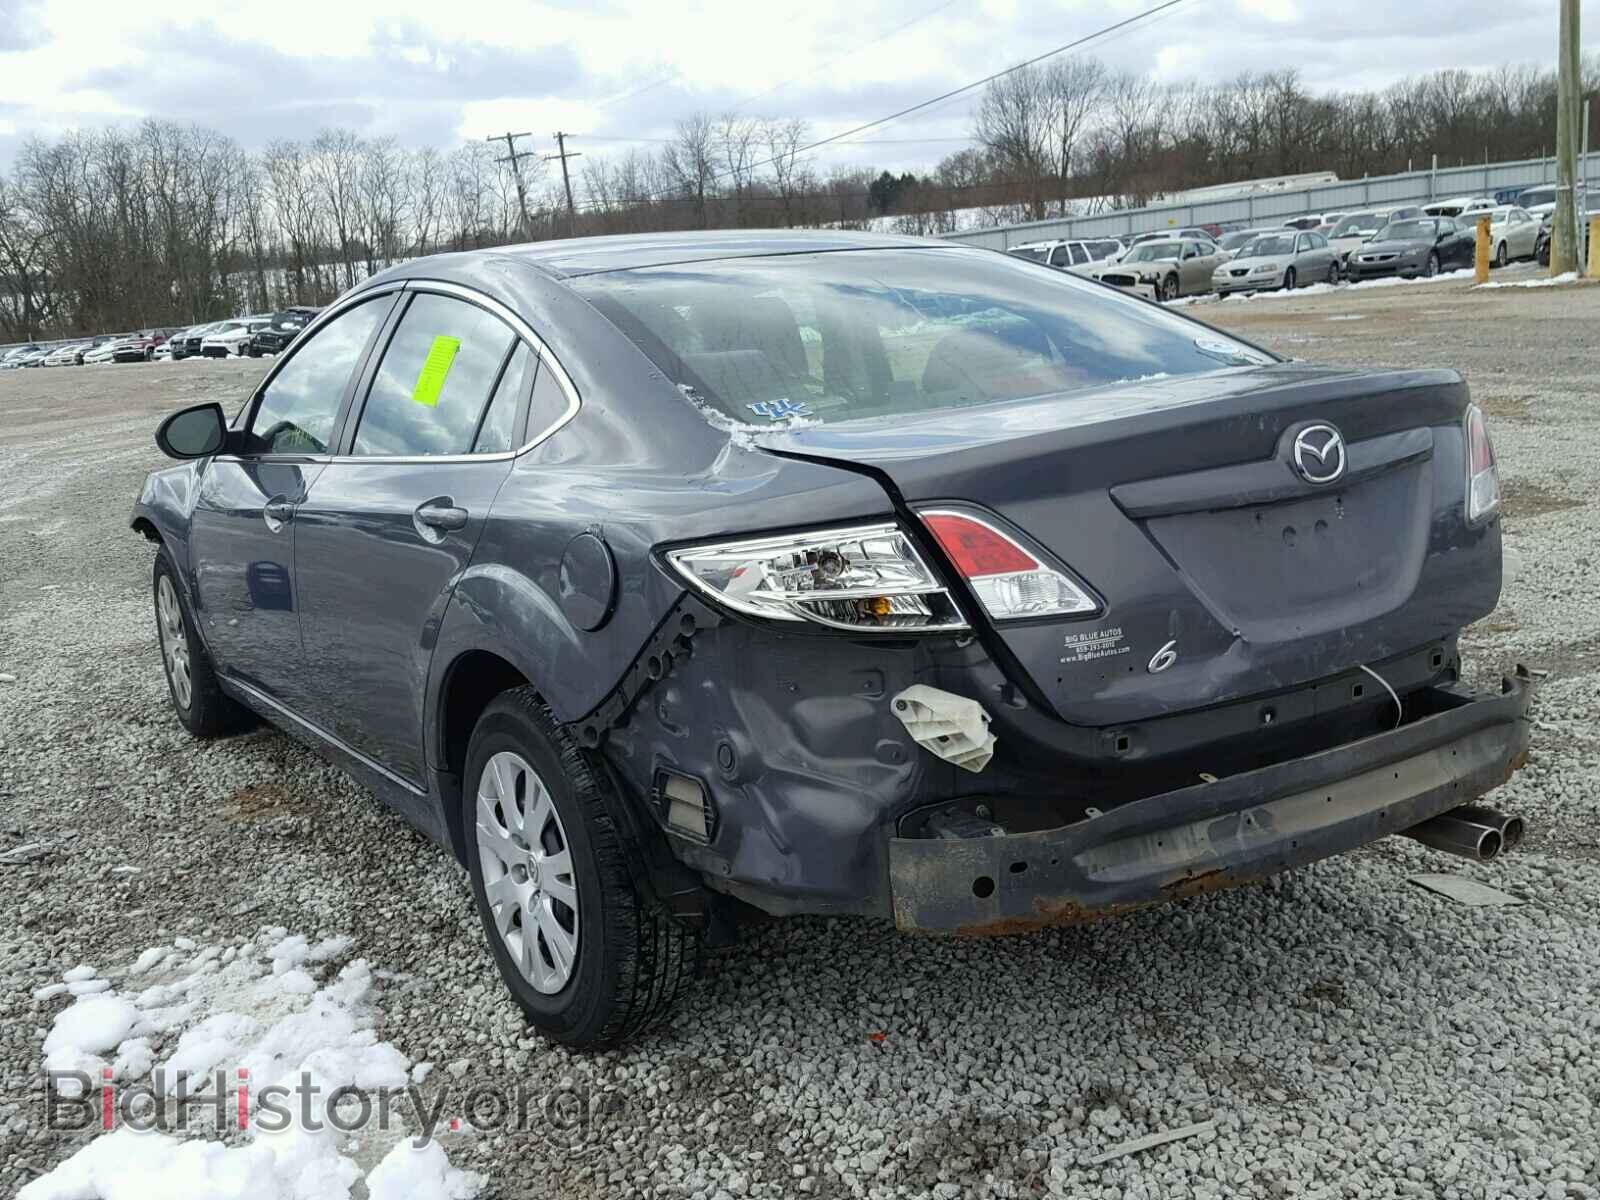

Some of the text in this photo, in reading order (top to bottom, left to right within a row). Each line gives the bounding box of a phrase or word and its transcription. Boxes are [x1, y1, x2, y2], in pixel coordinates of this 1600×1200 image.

[1065, 627, 1122, 643] BIG BLUE AUTOS
[1060, 646, 1131, 663] www.BigBlueAutos.com
[1148, 640, 1177, 673] 6
